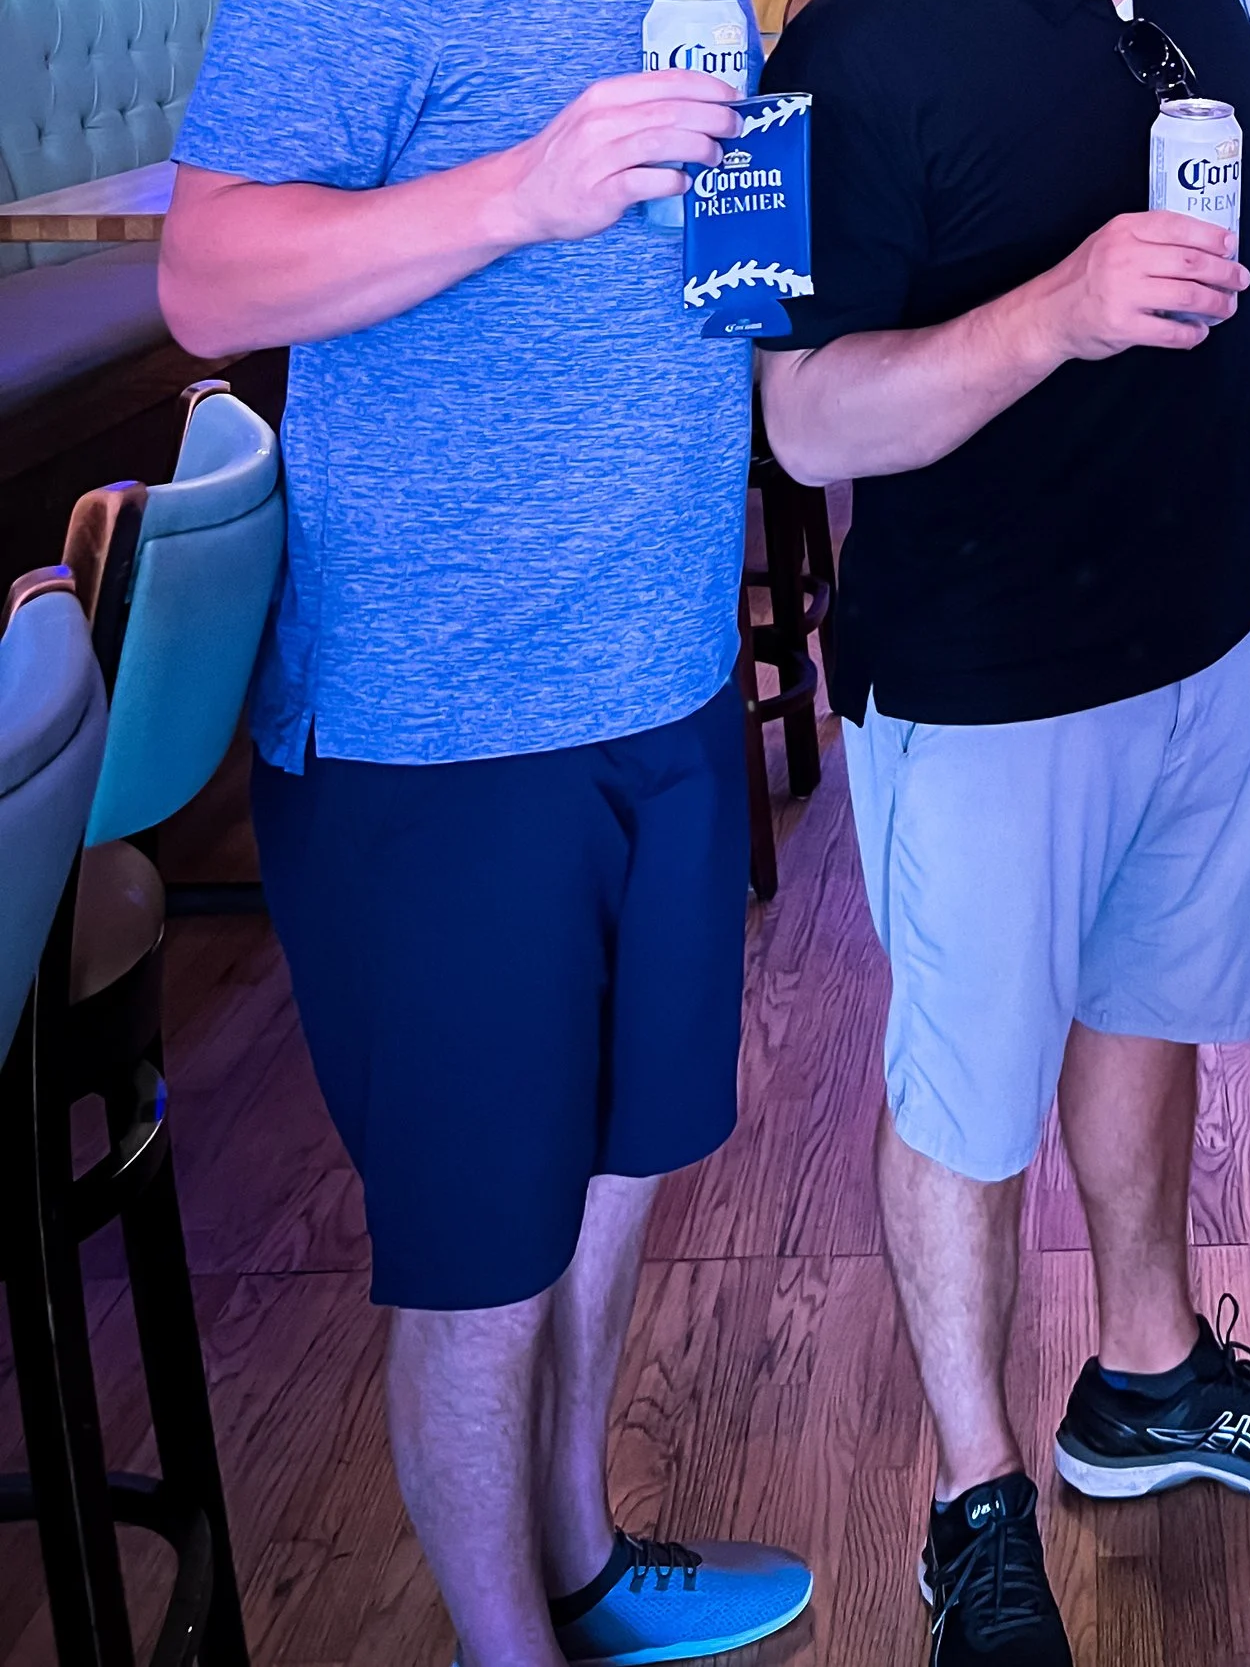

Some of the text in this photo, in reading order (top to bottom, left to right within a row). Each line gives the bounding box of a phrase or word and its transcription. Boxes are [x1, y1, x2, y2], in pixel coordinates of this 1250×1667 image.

[669, 43, 748, 74] Coro
[694, 168, 782, 198] Corona
[695, 193, 786, 218] PREMIER
